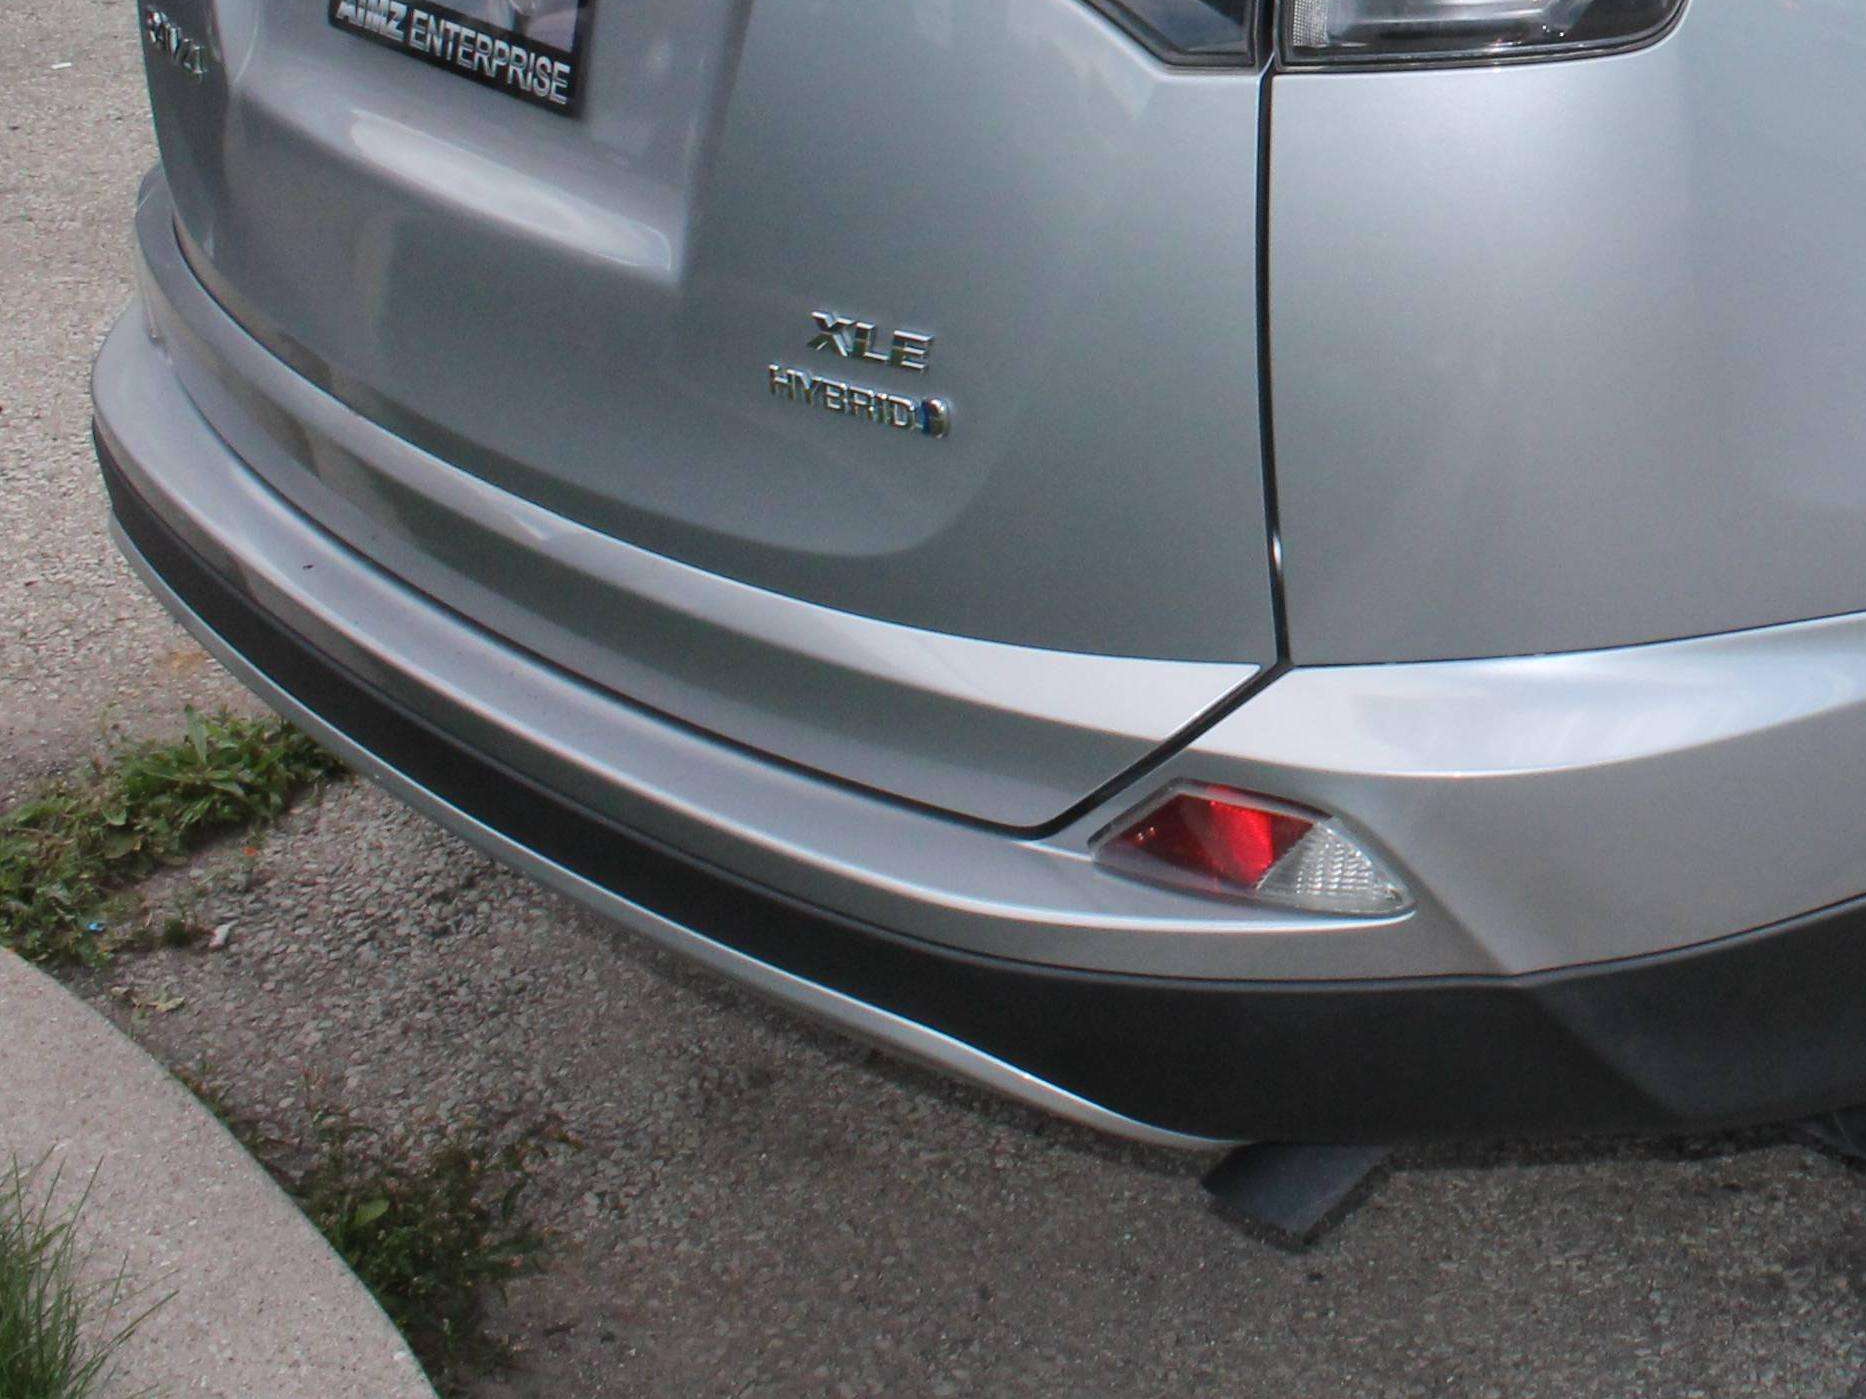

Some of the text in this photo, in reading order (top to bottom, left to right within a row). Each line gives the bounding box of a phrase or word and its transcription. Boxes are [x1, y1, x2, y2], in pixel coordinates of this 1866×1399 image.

[409, 8, 571, 105] ENTERPRISE
[808, 311, 935, 373] XLE
[768, 364, 918, 430] HYBRID
